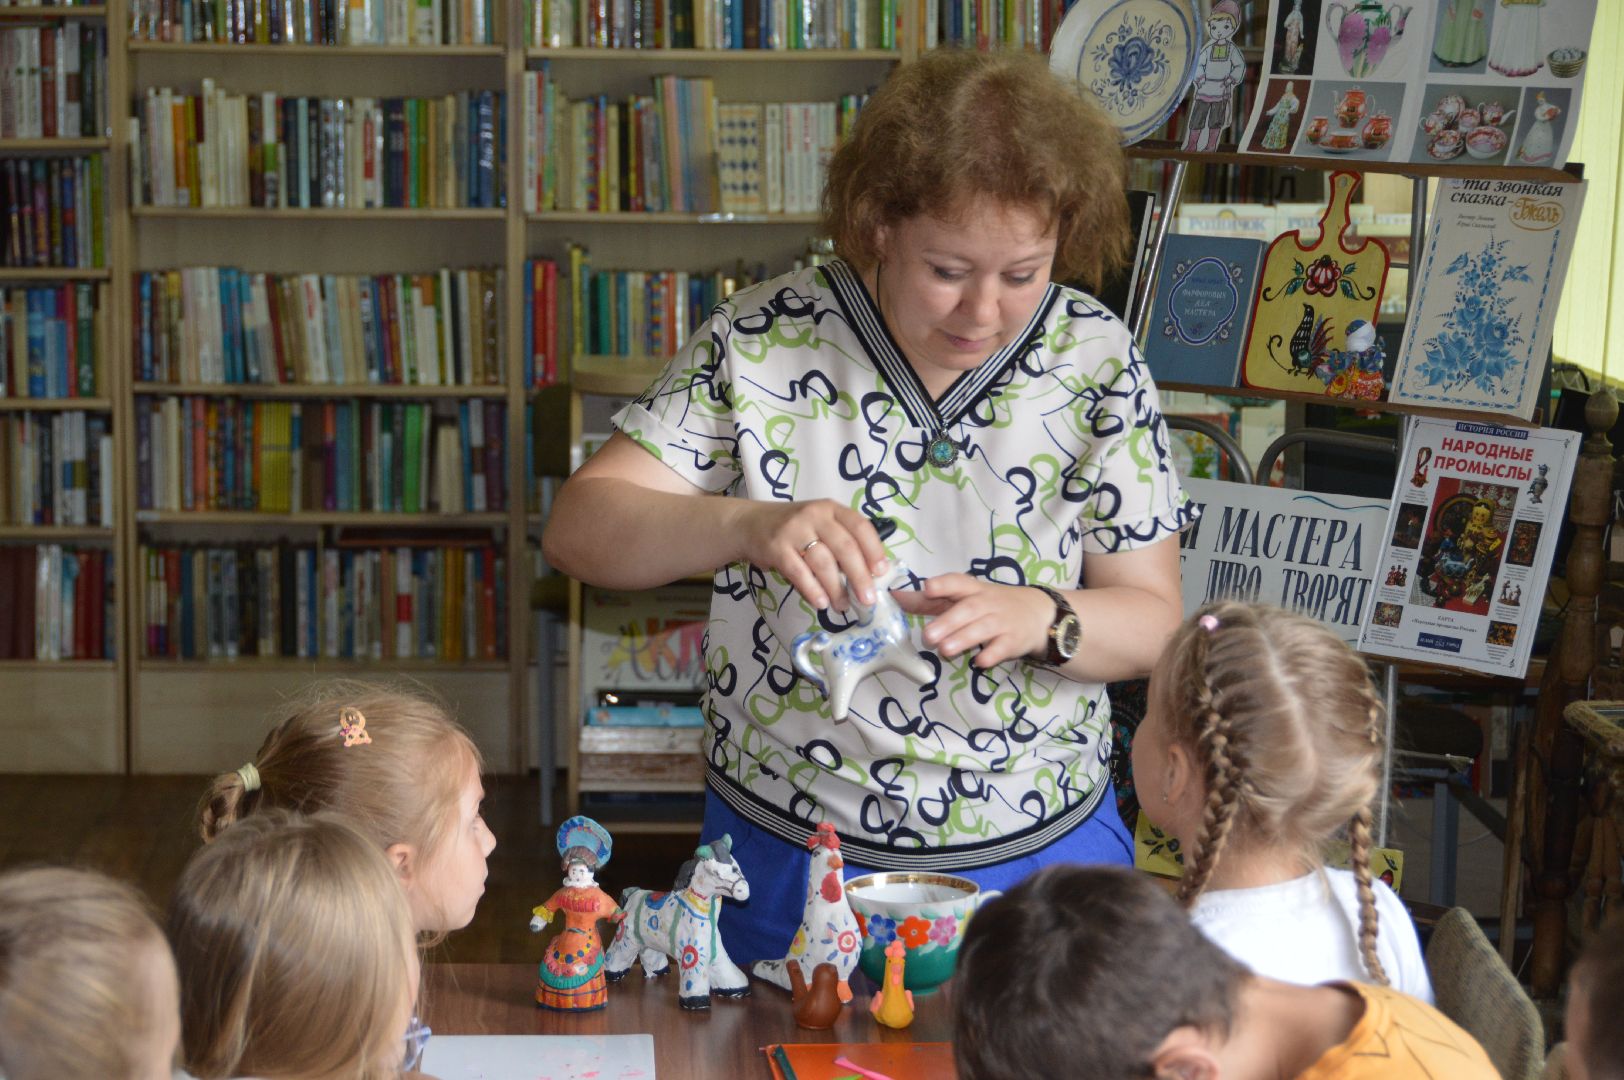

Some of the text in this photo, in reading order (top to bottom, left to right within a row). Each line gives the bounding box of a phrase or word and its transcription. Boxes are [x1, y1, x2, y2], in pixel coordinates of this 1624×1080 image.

[1493, 180, 1564, 197] звонкая
[1457, 422, 1527, 439] ИСТОРИЯ РОССИИ
[1441, 437, 1535, 462] НАРОДНЫЕ
[1433, 456, 1532, 481] ПРОМЫСЛЫ
[1214, 506, 1363, 571] МАСТЕРА
[1281, 568, 1372, 626] ТВОРЯТ
